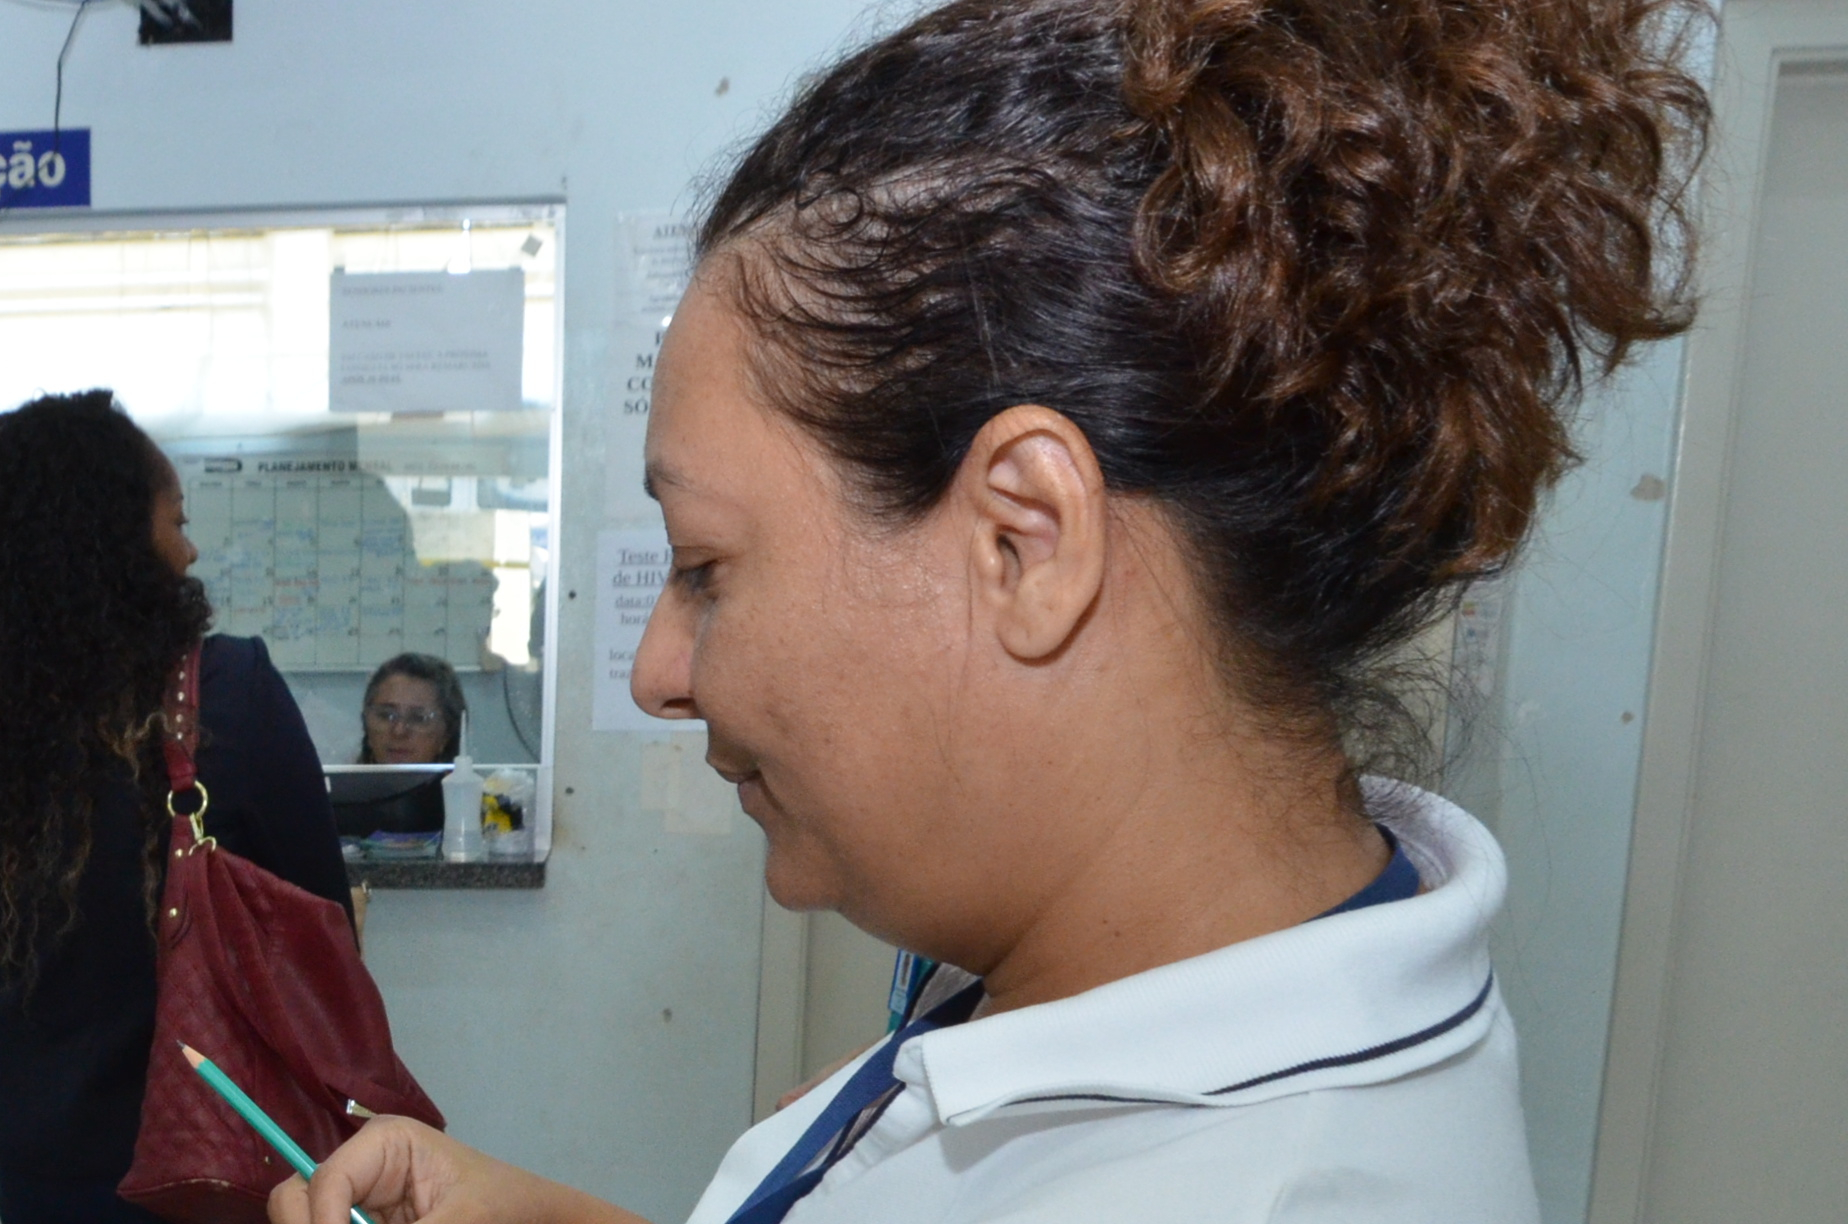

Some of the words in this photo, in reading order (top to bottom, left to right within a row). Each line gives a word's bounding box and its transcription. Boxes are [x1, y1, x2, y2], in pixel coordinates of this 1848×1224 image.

[258, 461, 345, 473] PLANEJAMENTO
[619, 549, 658, 565] Teste
[612, 571, 632, 587] de
